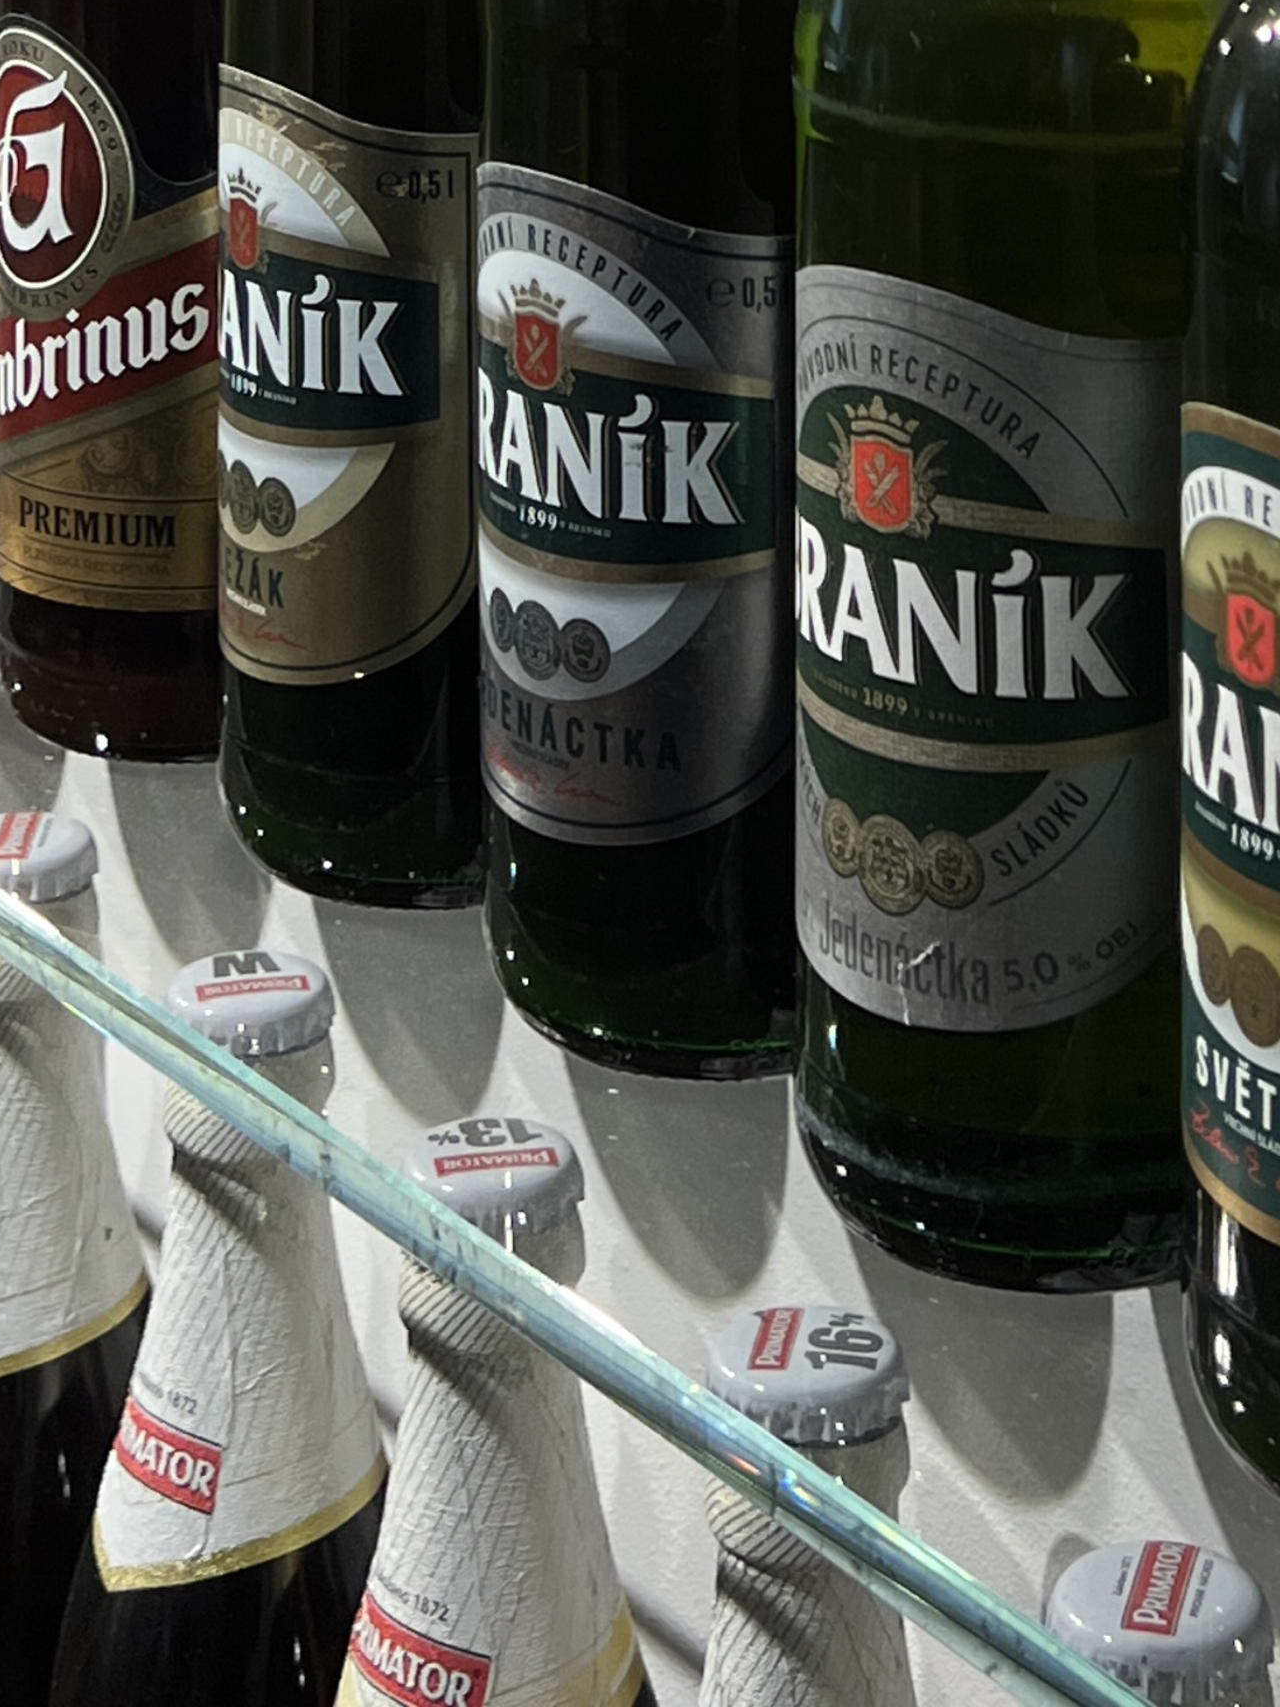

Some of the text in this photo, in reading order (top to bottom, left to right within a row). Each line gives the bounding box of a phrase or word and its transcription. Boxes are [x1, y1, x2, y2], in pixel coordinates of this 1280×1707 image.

[527, 223, 684, 345] RECEPTURA
[869, 343, 1042, 461] RECEPTURA
[17, 490, 179, 551] PREMIUM
[861, 686, 910, 717] 1899
[989, 777, 1093, 879] SLÁDKŮ
[1228, 820, 1276, 863] 1899
[819, 897, 991, 1007] Jedenáctka
[442, 1149, 554, 1173] PRIMATOR
[1131, 1540, 1188, 1628] PRIMATOR
